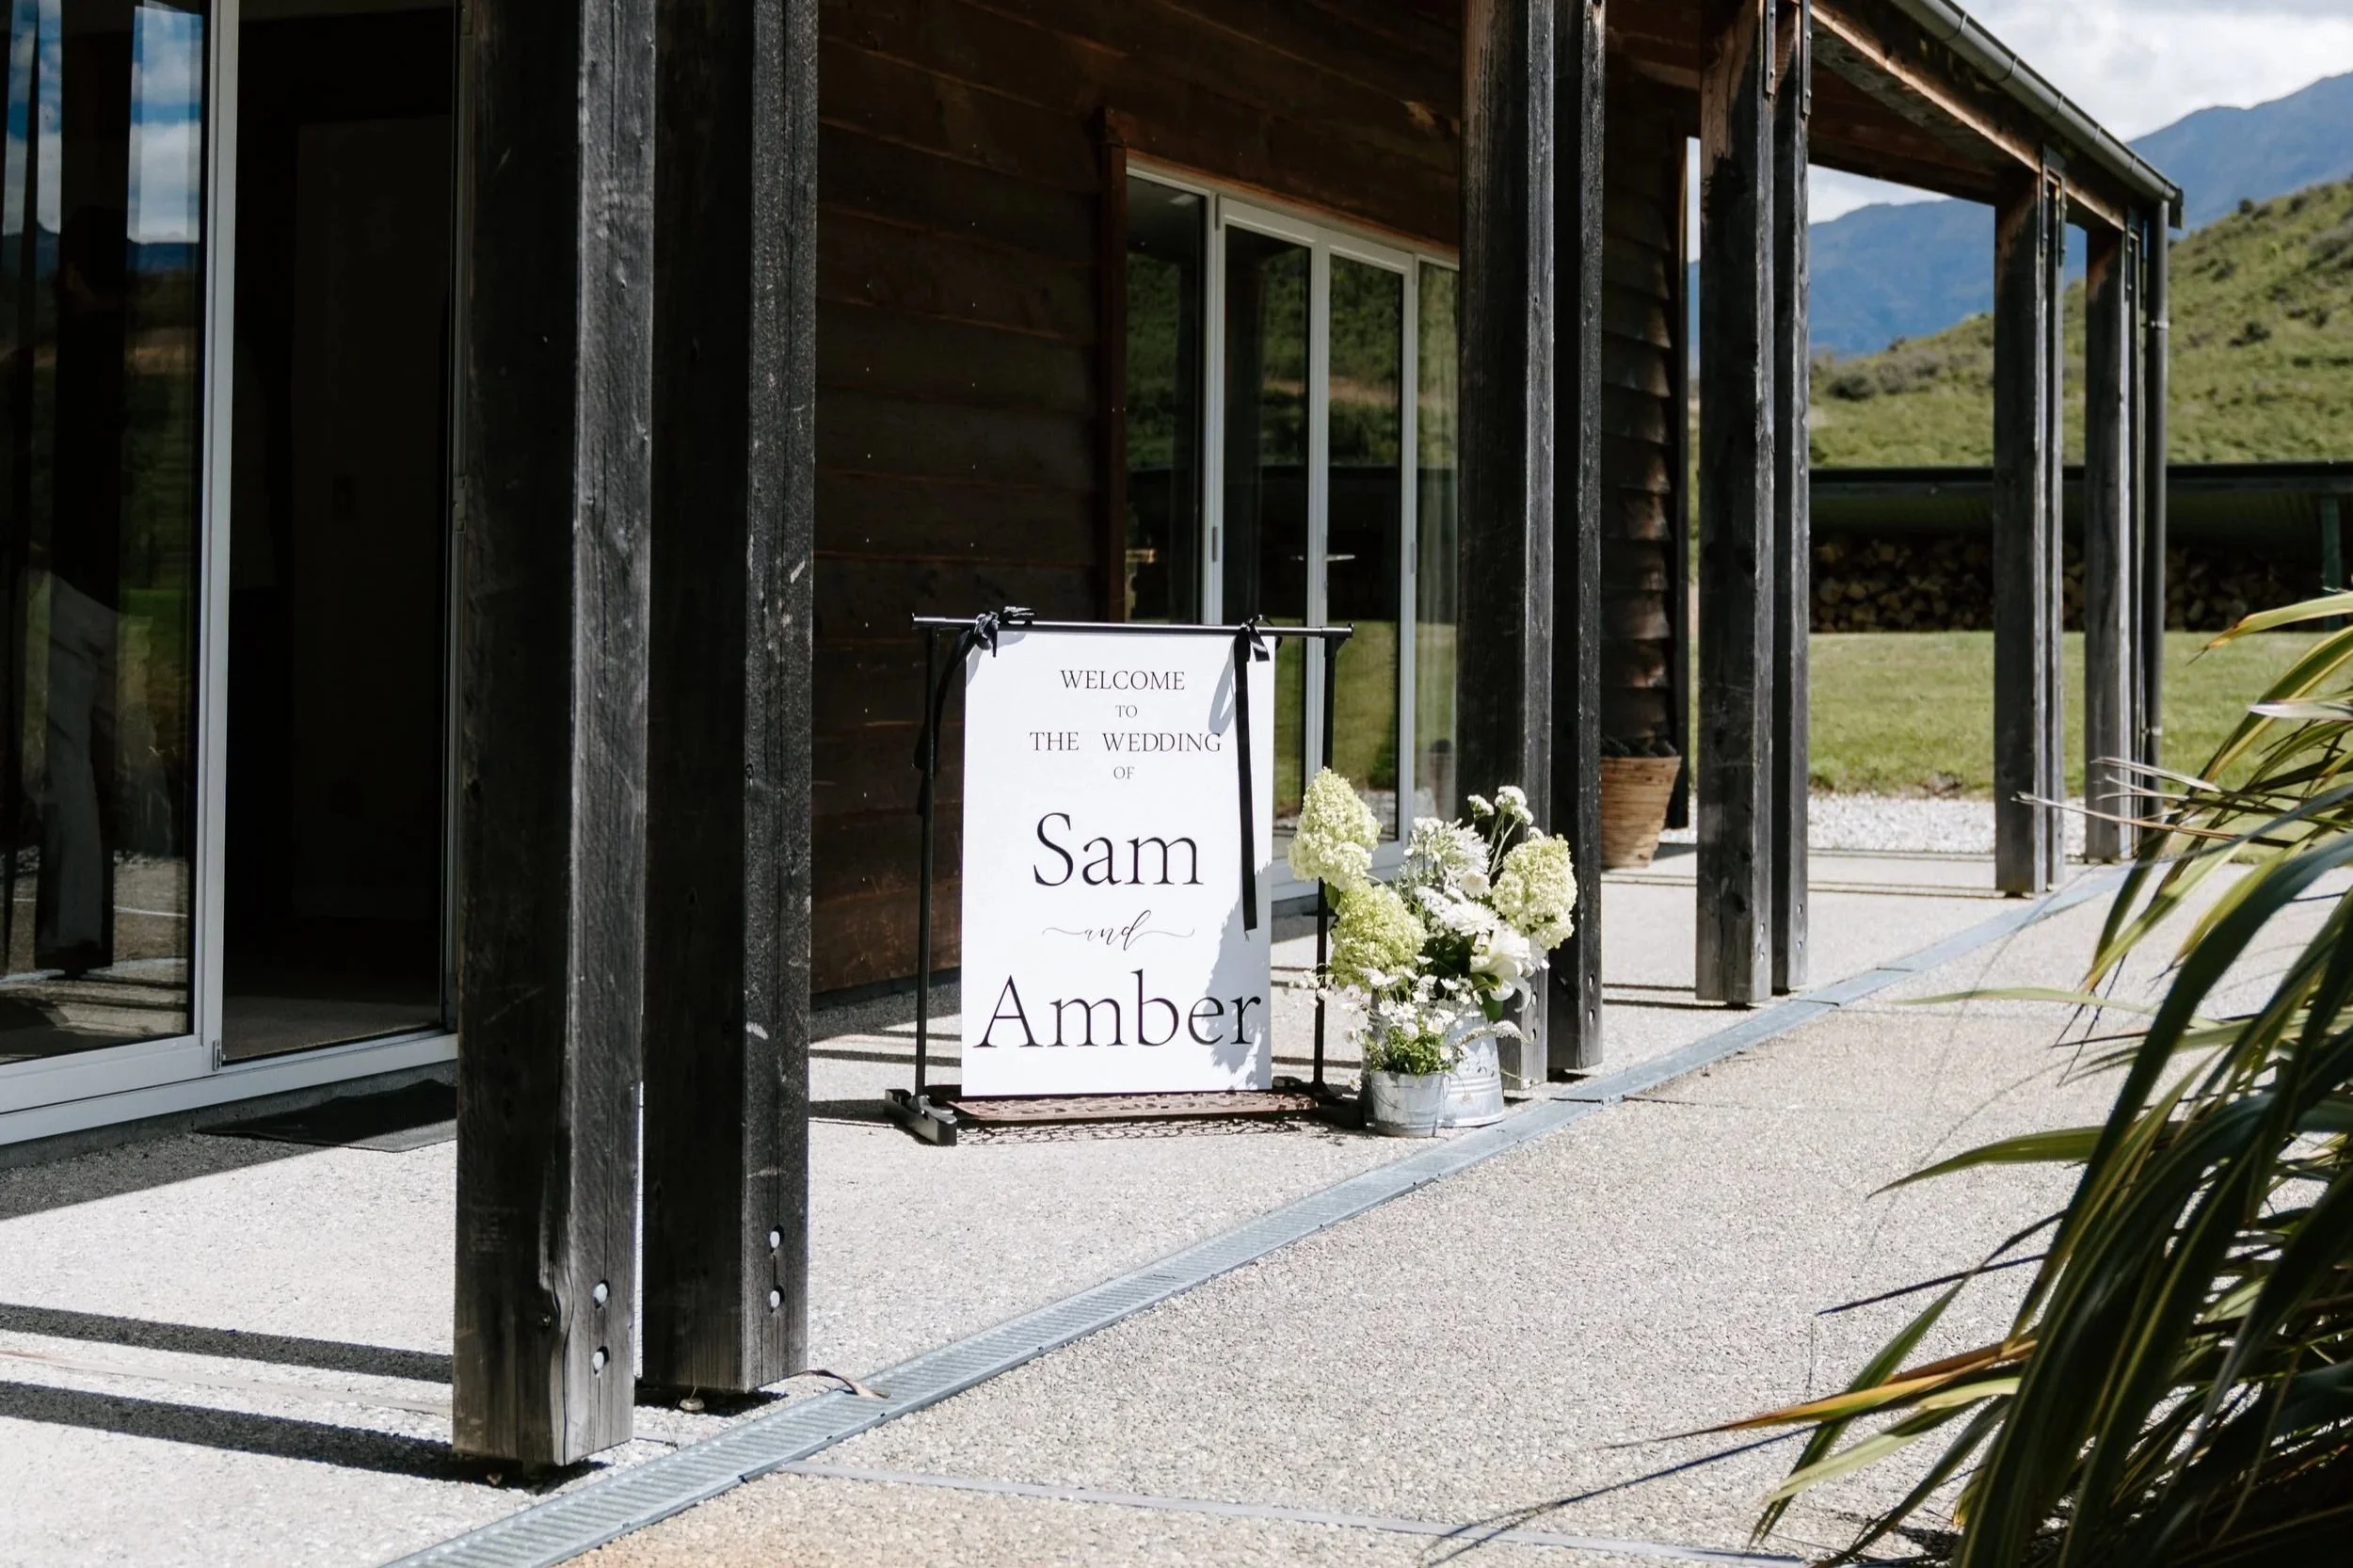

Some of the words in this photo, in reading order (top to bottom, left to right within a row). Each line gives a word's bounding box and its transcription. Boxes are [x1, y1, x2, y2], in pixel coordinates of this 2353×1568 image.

[1060, 669, 1185, 691] WELCOME
[1114, 704, 1138, 719] TO
[1029, 731, 1080, 752] THE
[1102, 732, 1222, 753] WEDDING
[1112, 765, 1135, 780] OF
[1033, 812, 1204, 887] Sam
[1043, 910, 1194, 952] and
[972, 968, 1261, 1048] Amber
